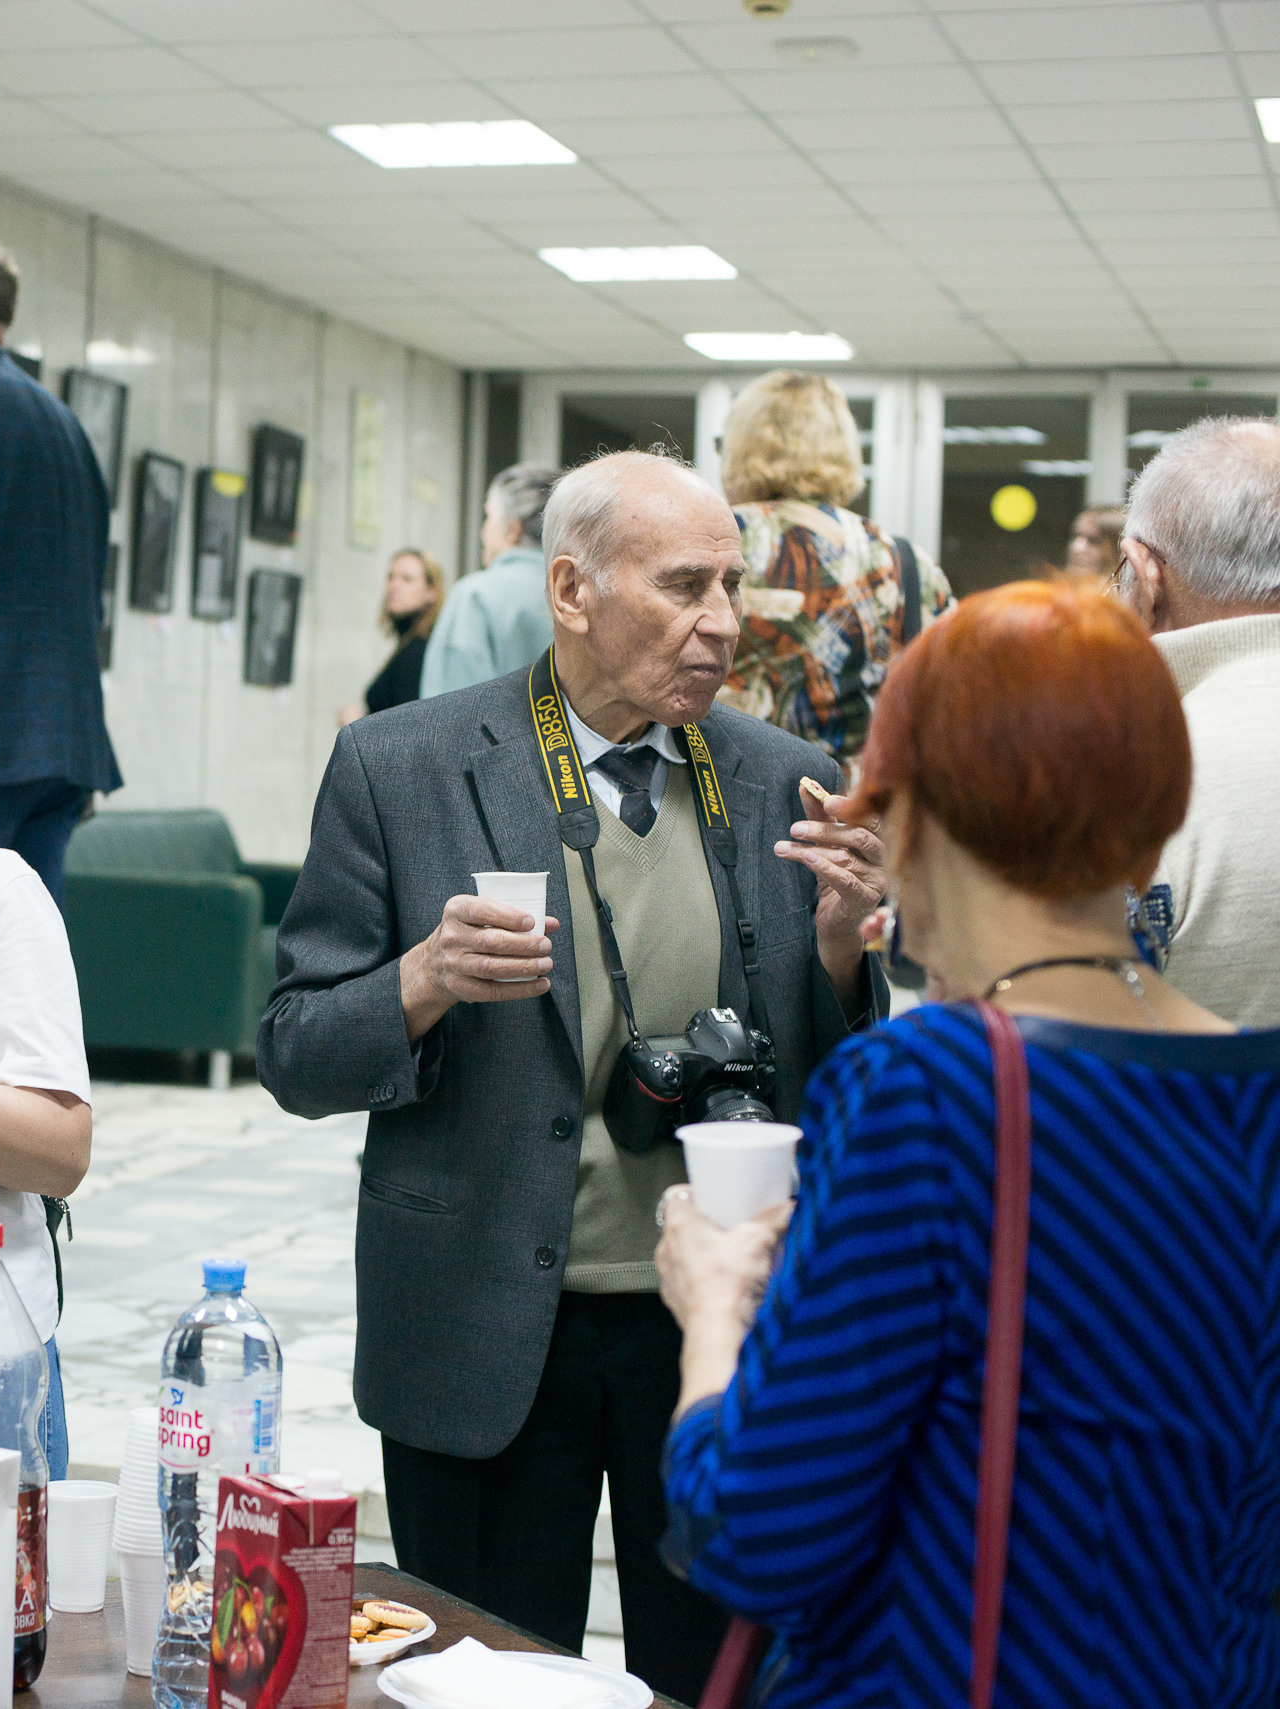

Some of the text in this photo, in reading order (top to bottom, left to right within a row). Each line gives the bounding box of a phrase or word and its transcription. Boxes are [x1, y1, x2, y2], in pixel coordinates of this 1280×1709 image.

[535, 694, 578, 799] Nikon D850
[685, 723, 721, 815] Nikon D85
[723, 1063, 754, 1072] Nikon
[160, 1406, 203, 1429] saint
